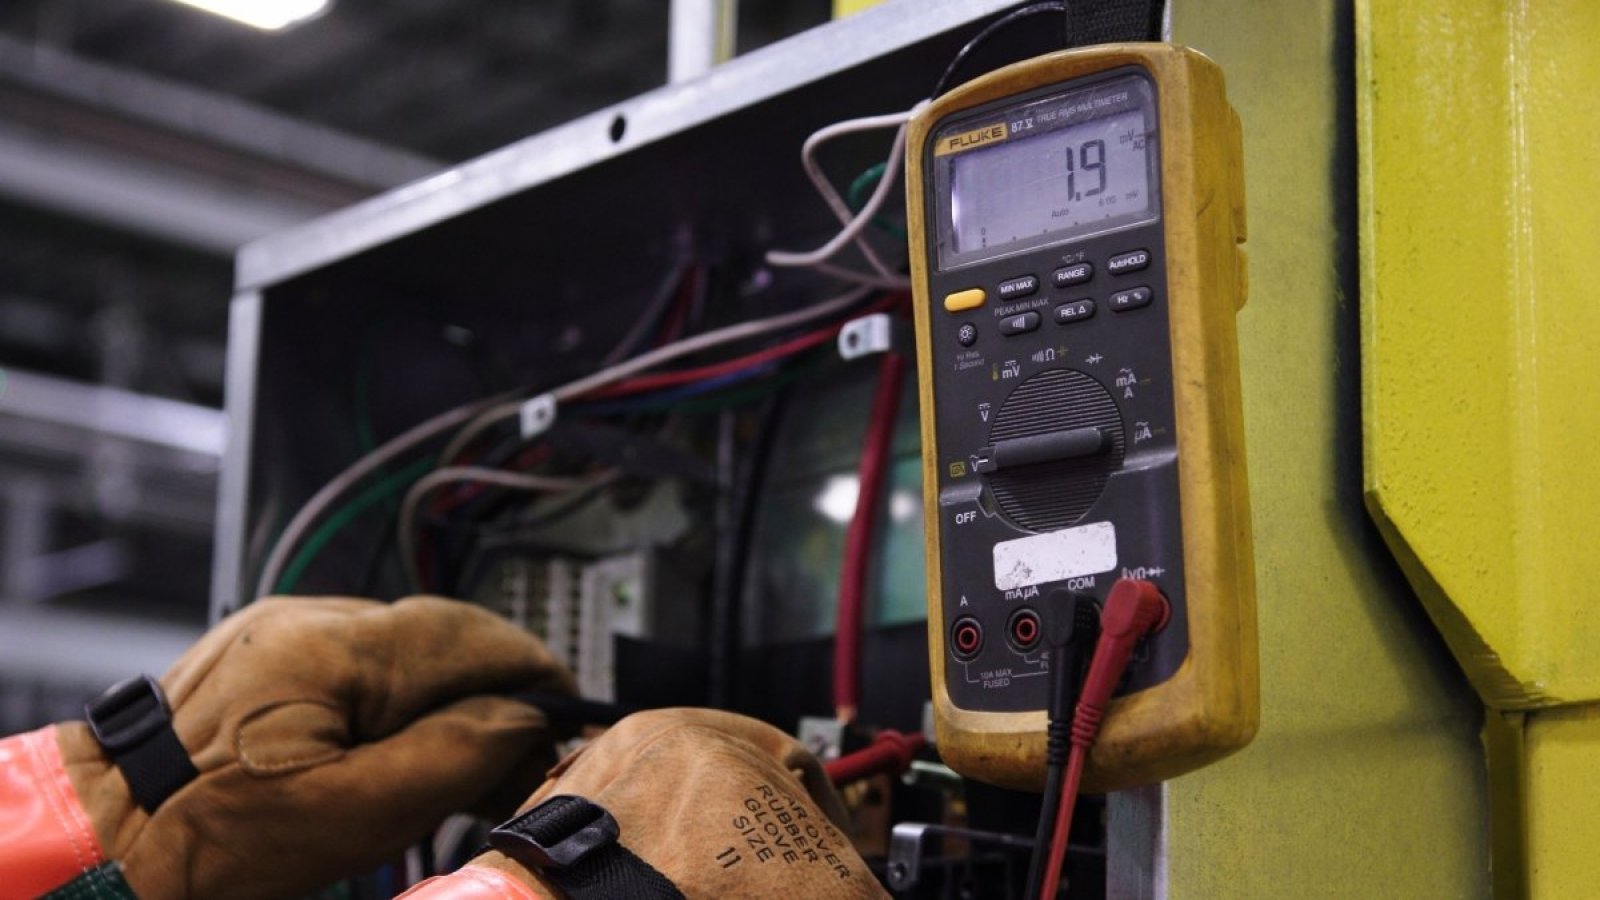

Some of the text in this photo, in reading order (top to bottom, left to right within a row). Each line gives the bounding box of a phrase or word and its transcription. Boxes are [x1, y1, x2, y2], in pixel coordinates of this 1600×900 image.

[1037, 111, 1057, 123] TRUE
[1011, 120, 1023, 133] 87
[950, 127, 1004, 149] FLUKE
[1066, 138, 1106, 202] 1.9
[1109, 255, 1146, 270] AutoHOLD
[1058, 268, 1086, 281] RANGE
[1001, 280, 1033, 294] MIN MAX
[994, 298, 1049, 317] PEAK MIN MAX
[1061, 308, 1076, 317] REL
[1002, 364, 1020, 379] mV
[1115, 372, 1137, 387] mA
[1123, 386, 1134, 399] A
[955, 511, 977, 524] OFF
[1067, 576, 1096, 592] COM
[960, 595, 968, 606] A
[983, 678, 1010, 689] FUSED
[744, 798, 800, 864] GLOVE
[755, 784, 819, 863] RUBBER
[733, 815, 775, 863] SIZE
[806, 825, 850, 880] OVER
